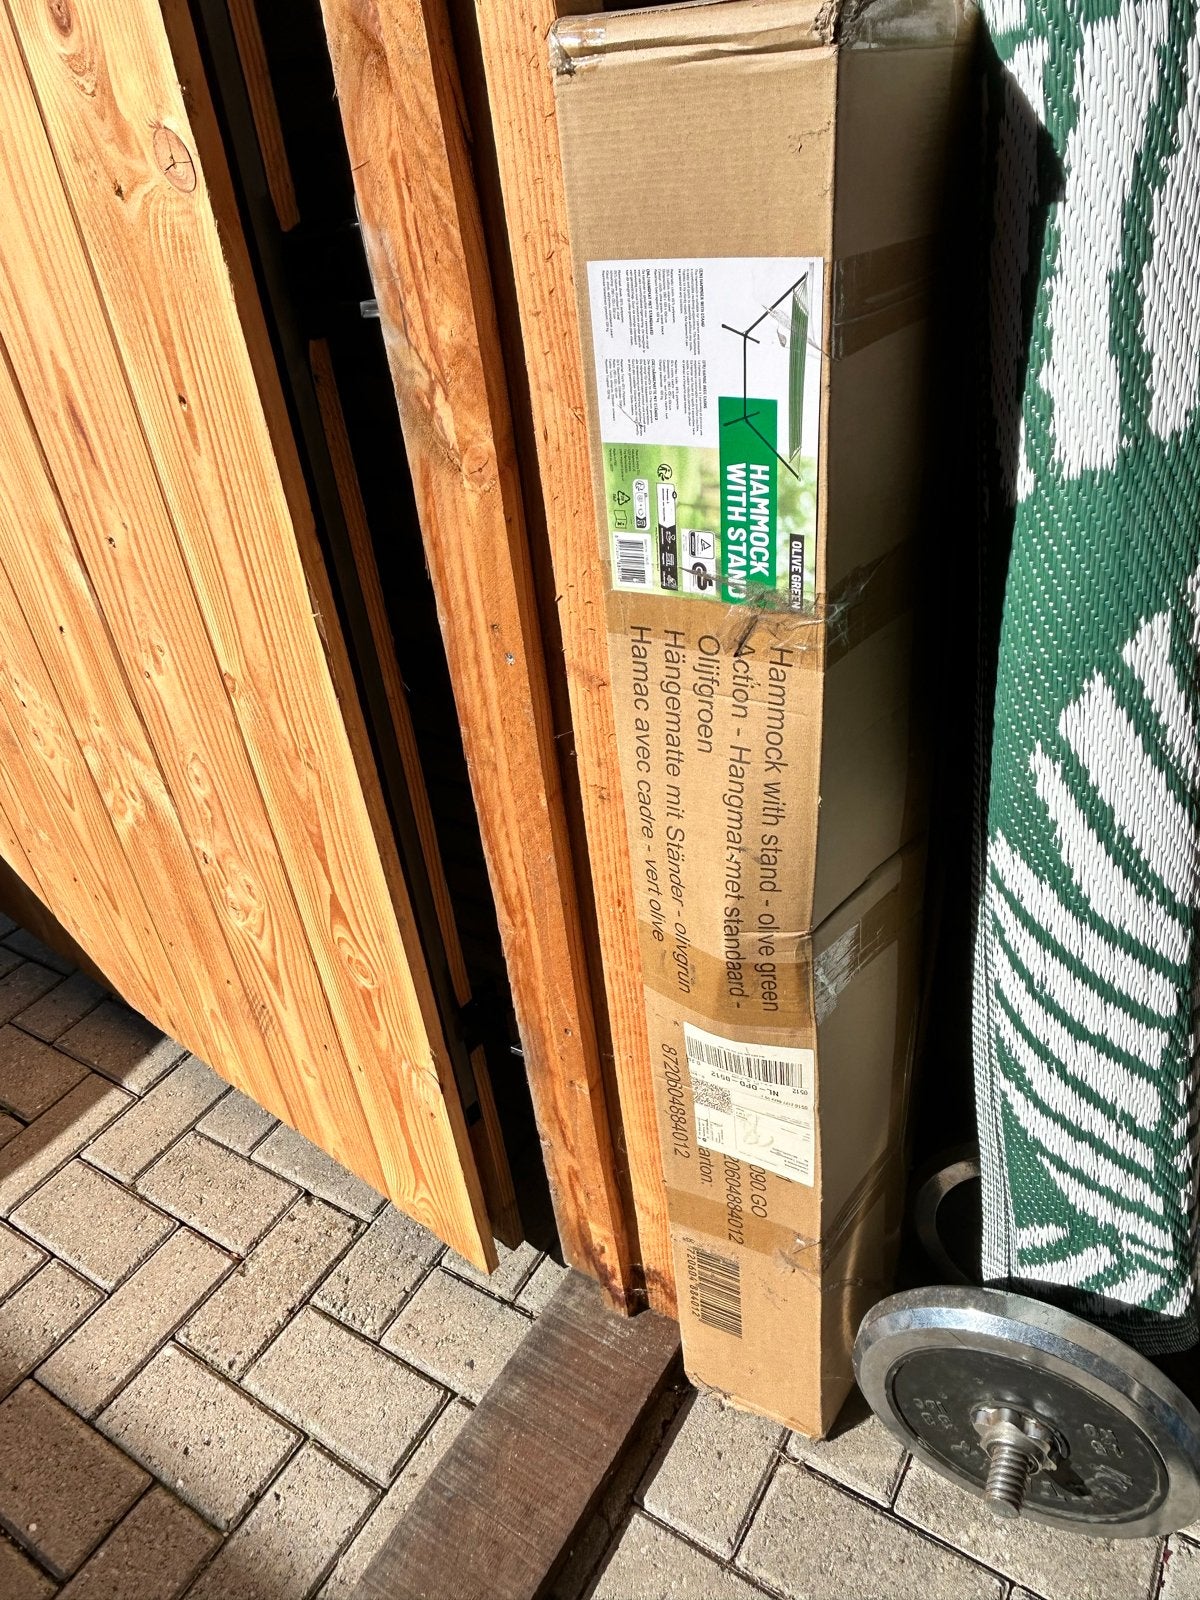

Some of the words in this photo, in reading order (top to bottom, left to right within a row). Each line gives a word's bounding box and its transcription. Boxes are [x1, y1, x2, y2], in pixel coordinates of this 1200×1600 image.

[727, 463, 747, 523] WITH
[749, 464, 769, 577] HAMMOCK
[727, 527, 747, 598] STAND
[790, 541, 803, 574] OLIVE
[790, 574, 802, 610] GREEN
[630, 626, 653, 711] Hamac
[693, 634, 721, 753] Olijfgroen
[731, 641, 756, 718] Action
[659, 630, 686, 777] Hängematte
[764, 646, 794, 773] Hammock
[634, 717, 652, 772] avec
[637, 779, 656, 839] cadre
[665, 784, 685, 818] mit
[761, 781, 785, 826] with
[645, 859, 663, 893] vert
[666, 825, 687, 907] Ständer
[759, 834, 781, 893] stand
[649, 900, 667, 942] olive
[757, 913, 779, 957] olive
[723, 906, 750, 996] standaard
[755, 962, 781, 1012] green
[661, 1043, 690, 1158] 8720604884012
[697, 1145, 714, 1187] arton:
[749, 1164, 768, 1218] 090.GO
[723, 1155, 744, 1245] 20604884012
[687, 1248, 698, 1282] 720604
[689, 1284, 700, 1317] 884012
